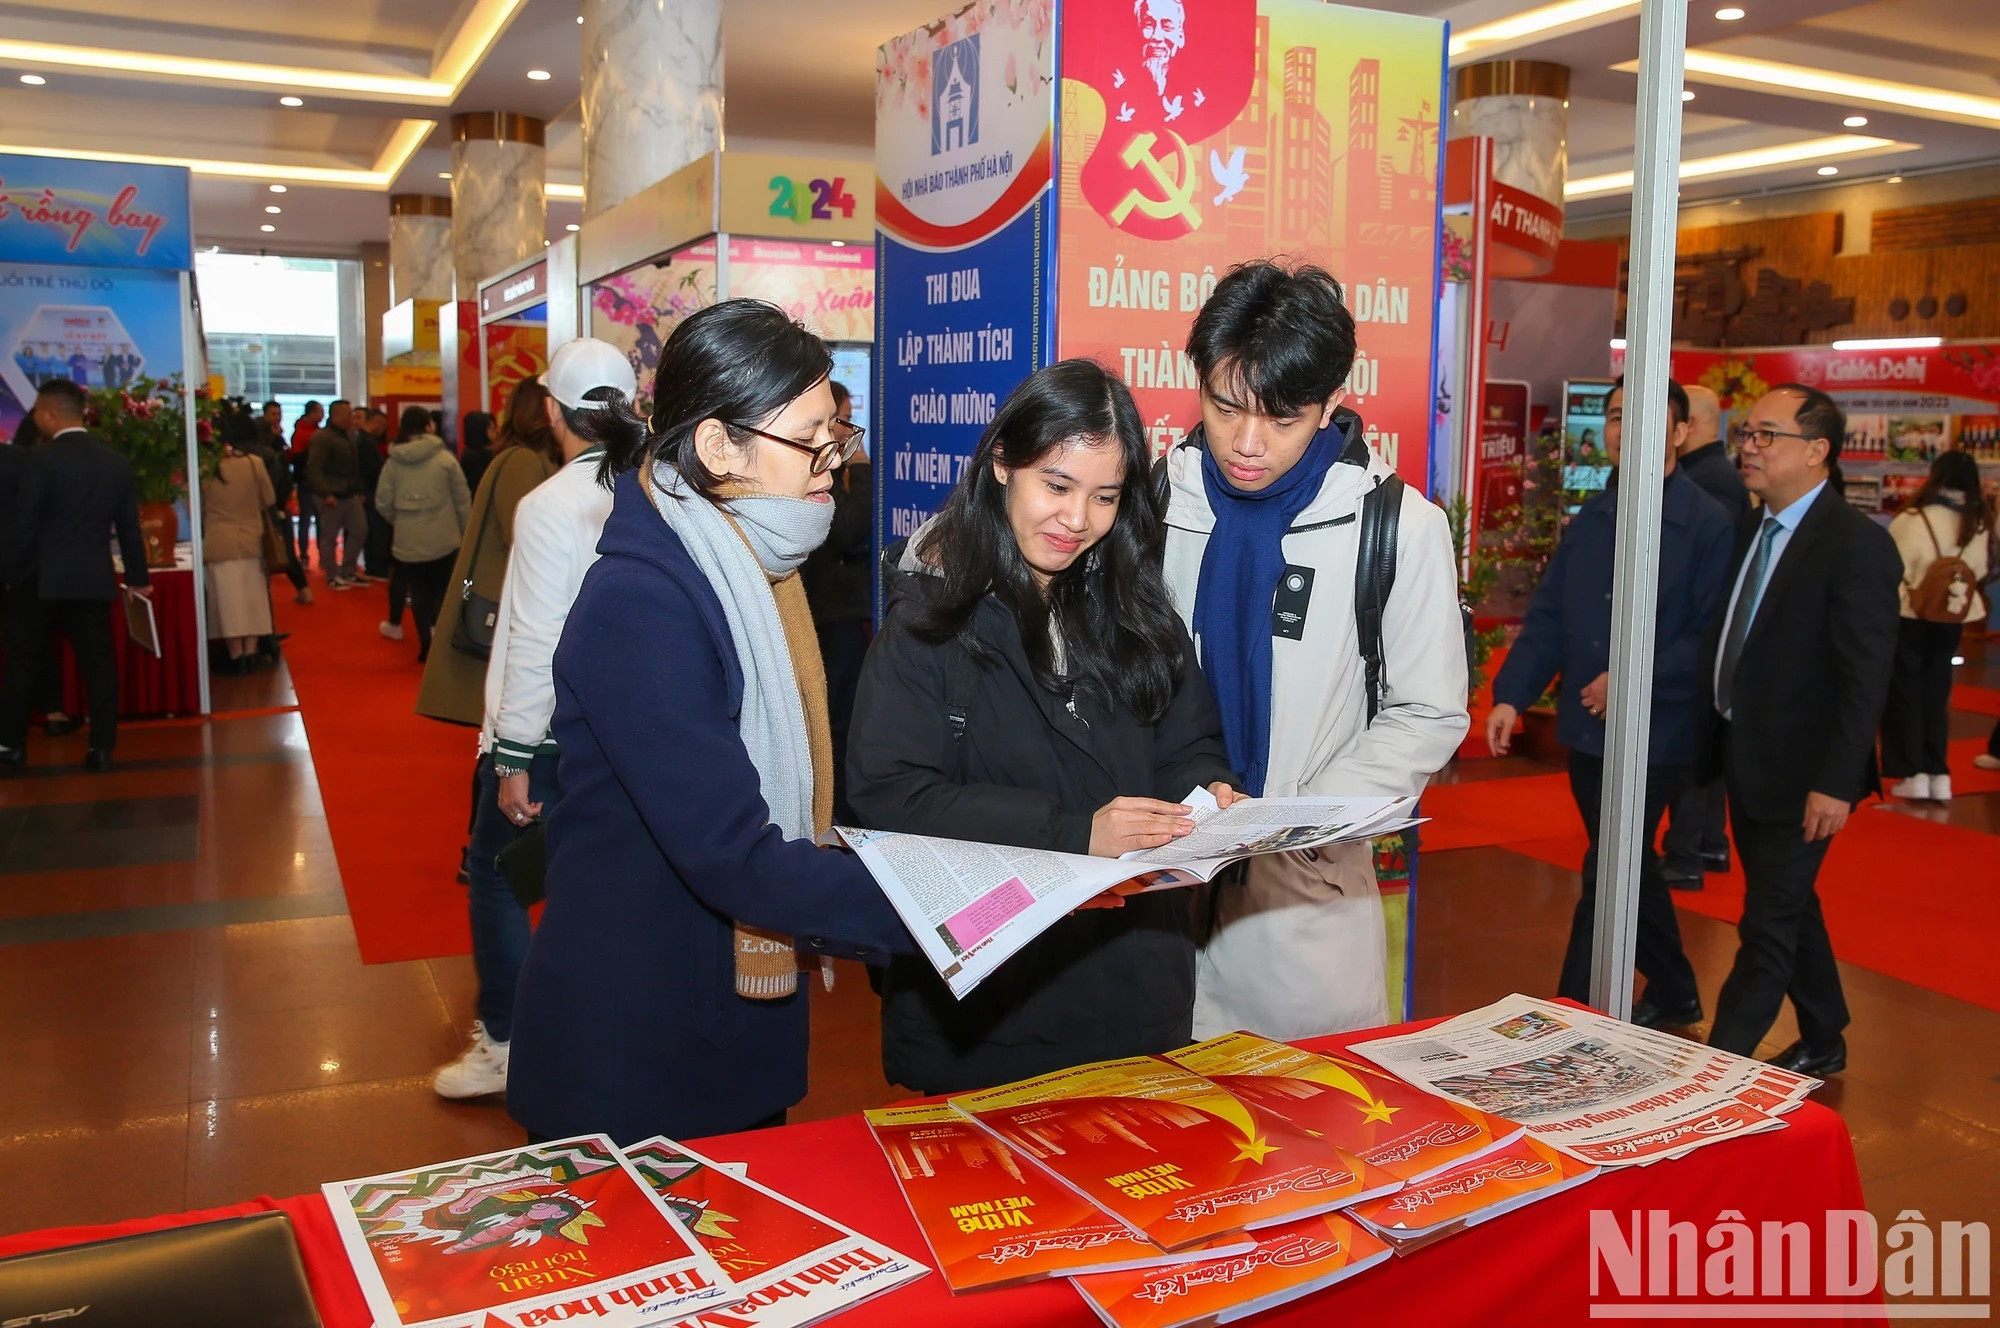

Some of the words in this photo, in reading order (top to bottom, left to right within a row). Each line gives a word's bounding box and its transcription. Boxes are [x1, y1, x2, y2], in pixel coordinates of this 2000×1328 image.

[902, 177, 913, 202] HỘI
[915, 174, 928, 196] NHÀ
[929, 169, 943, 192] BÁO
[944, 163, 969, 189] THÀNH
[970, 155, 986, 183] PHỐ
[986, 153, 998, 179] HÀ
[999, 150, 1013, 179] NỘI
[768, 176, 856, 227] 2024
[20, 188, 98, 252] rồng
[107, 184, 169, 256] bay
[926, 273, 948, 305] THI
[951, 268, 981, 303] ĐUA
[1088, 254, 1171, 311] ĐẢNG
[1356, 277, 1409, 324] DÂN
[898, 331, 924, 373] LẬP
[927, 326, 974, 366] THÀNH
[978, 322, 1013, 363] TÍCH
[1120, 341, 1201, 389] THÀN
[910, 387, 946, 425] CHÀO
[951, 386, 996, 425] MỪNG
[895, 442, 911, 481] KỶ
[915, 446, 950, 490] NIỆM
[987, 1088, 1011, 1098] ĐOÀN
[1011, 1084, 1027, 1092] ĐẠI
[1027, 1080, 1044, 1088] BÁO
[1666, 1083, 1715, 1101] Xuất
[970, 1094, 987, 1102] KẾT
[1628, 1094, 1678, 1114] khẩu
[1104, 1171, 1149, 1187] NAM
[1142, 1163, 1183, 1178] VIỆT
[1122, 1181, 1171, 1200] thế
[949, 1201, 995, 1218] NAM
[994, 1196, 1036, 1211] VIỆT
[957, 1213, 1005, 1234] thế
[371, 1233, 411, 1248] 2024
[544, 1249, 588, 1269] hội
[791, 1247, 894, 1285] Tinh
[490, 1260, 539, 1280] ngộ
[497, 1262, 597, 1293] Xuân
[604, 1267, 715, 1308] Tinh
[728, 1280, 812, 1316] hoa
[517, 1296, 611, 1328] hoa
